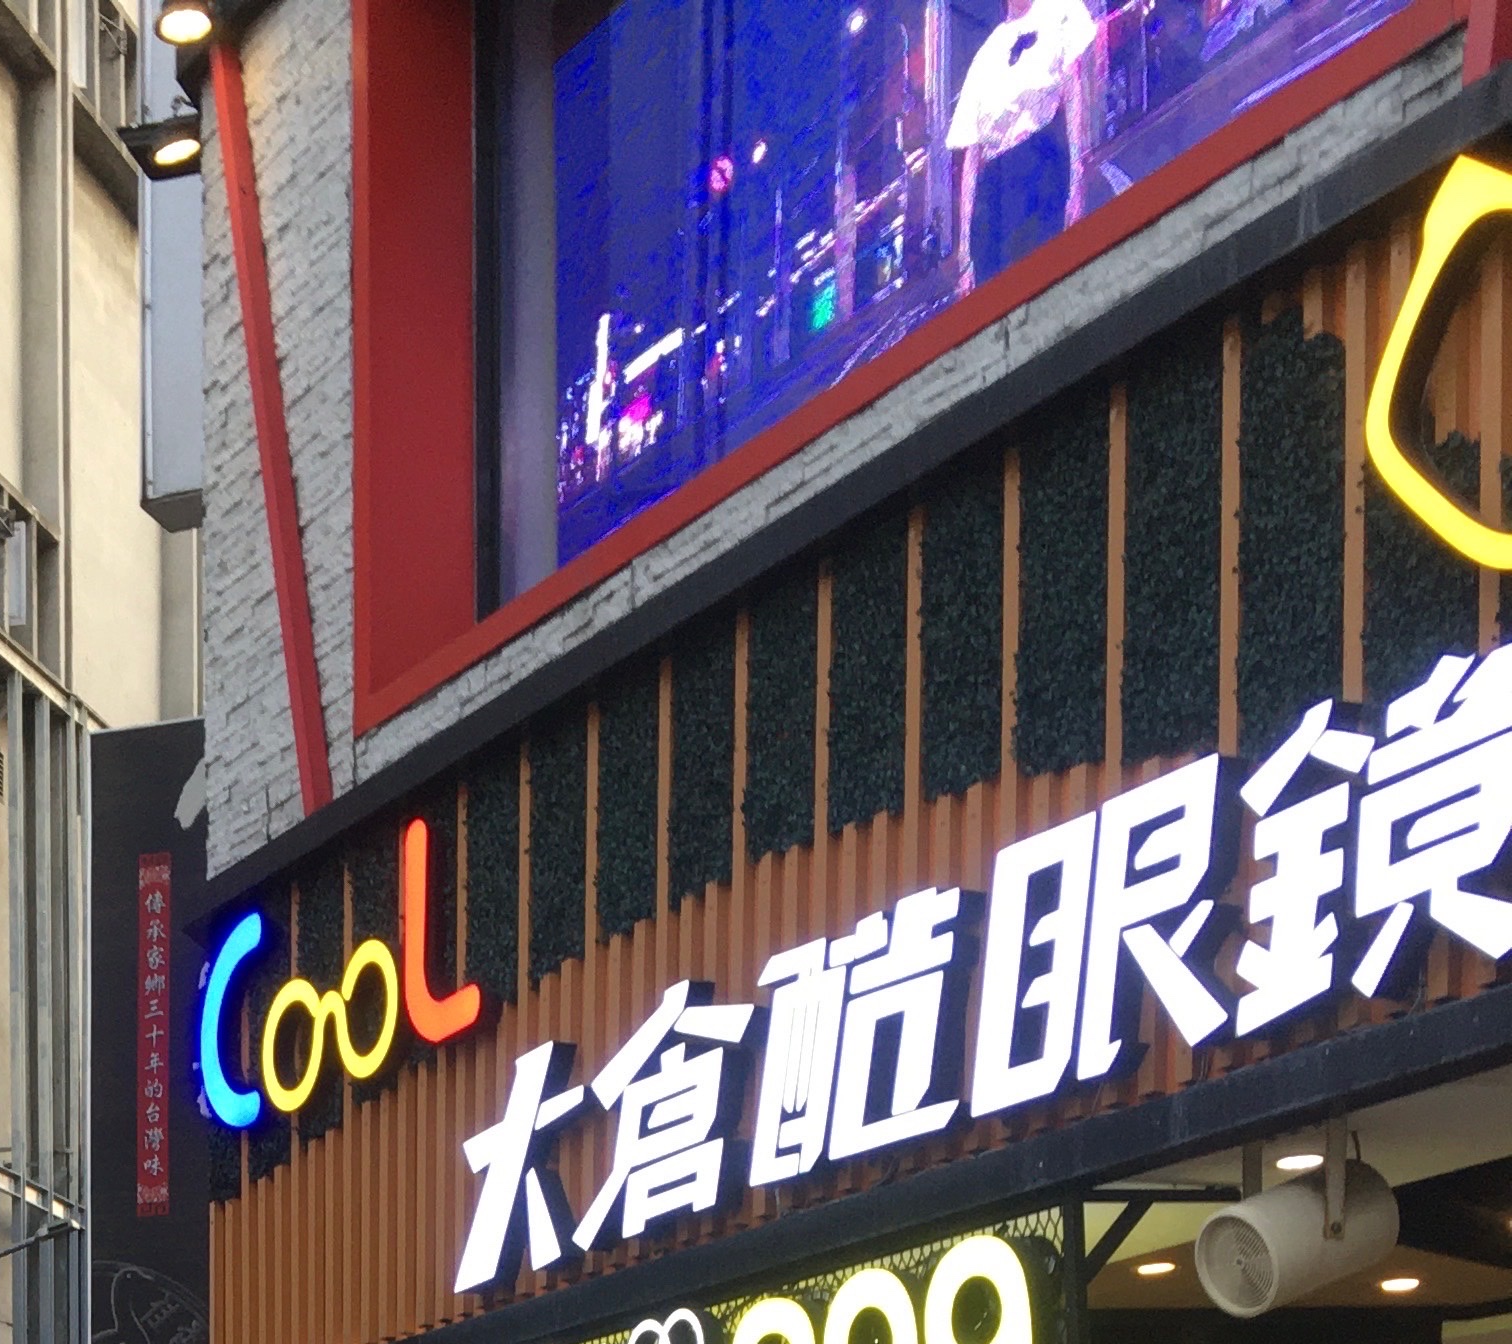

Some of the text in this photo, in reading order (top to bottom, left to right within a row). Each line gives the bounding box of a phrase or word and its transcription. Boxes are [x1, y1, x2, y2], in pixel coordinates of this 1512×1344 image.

[144, 892, 166, 1177] 傳承家鄉三十年的台灣味
